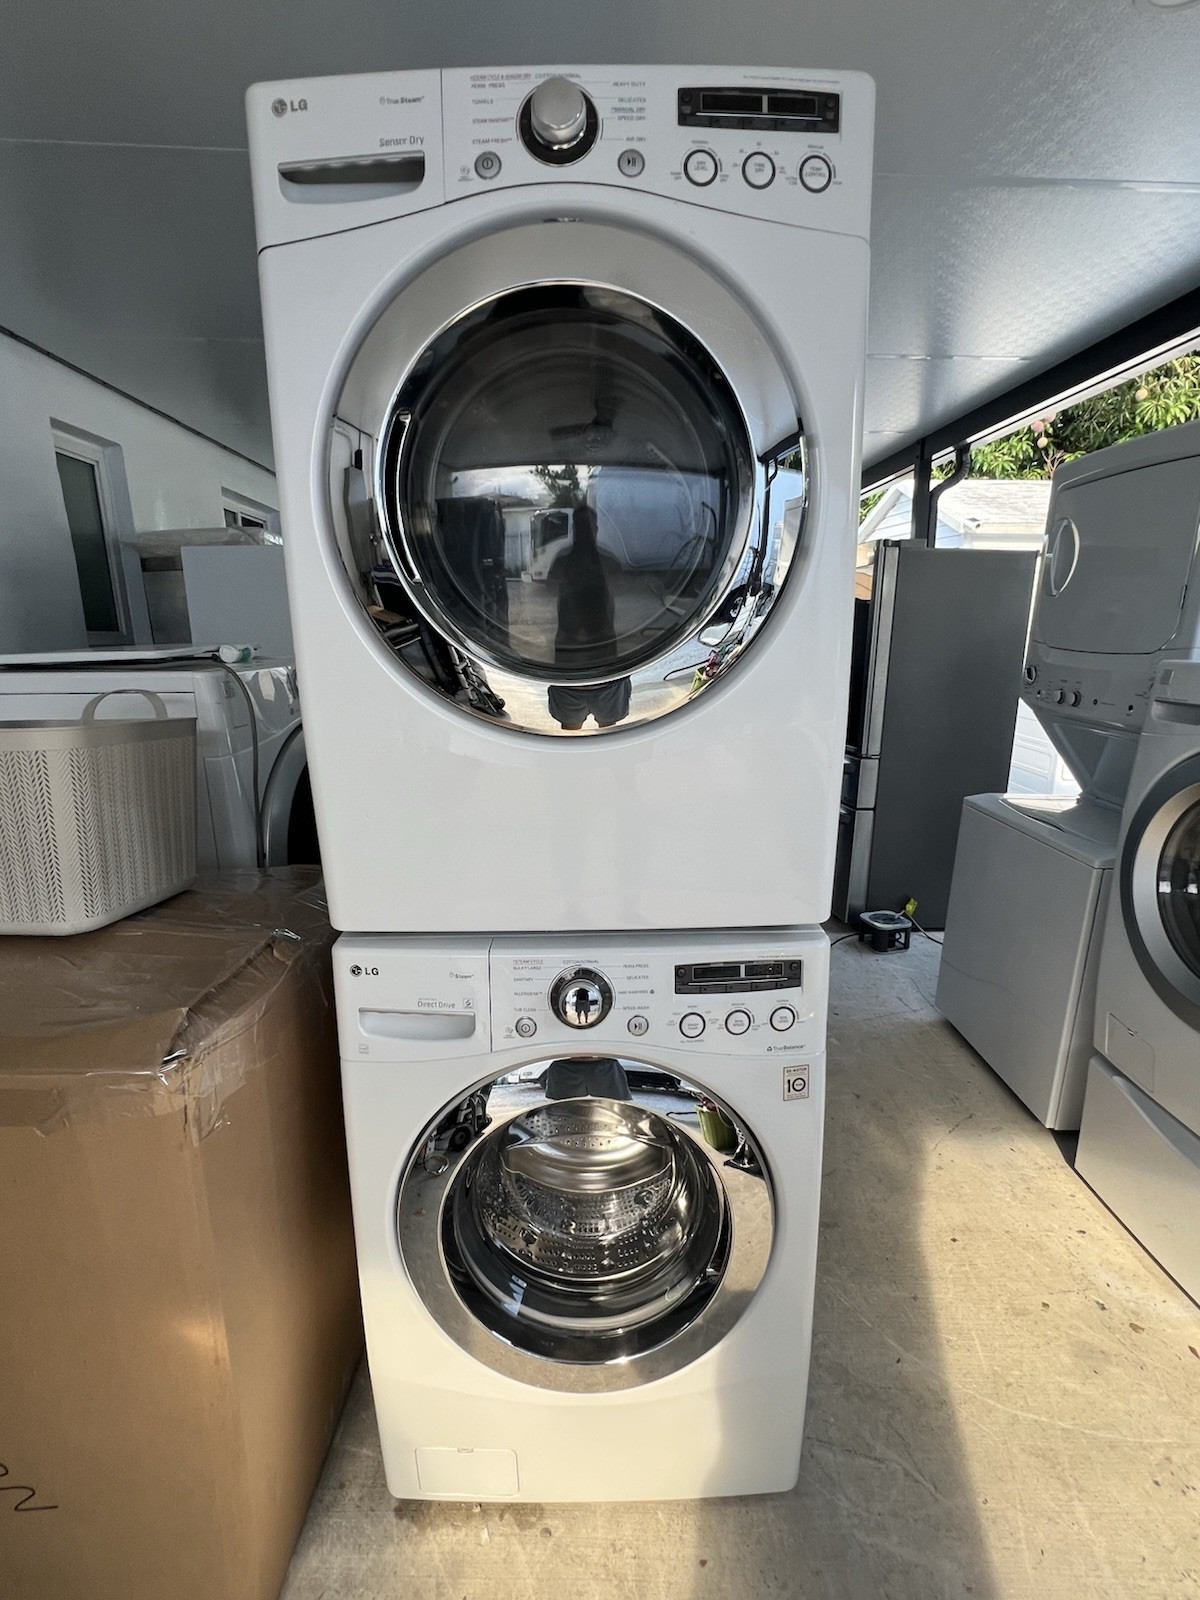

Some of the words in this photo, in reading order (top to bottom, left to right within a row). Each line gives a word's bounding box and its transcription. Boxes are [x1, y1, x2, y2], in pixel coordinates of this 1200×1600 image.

[290, 99, 308, 112] LG
[409, 135, 424, 146] Dry
[365, 967, 379, 976] LG
[788, 1077, 806, 1093] 10
